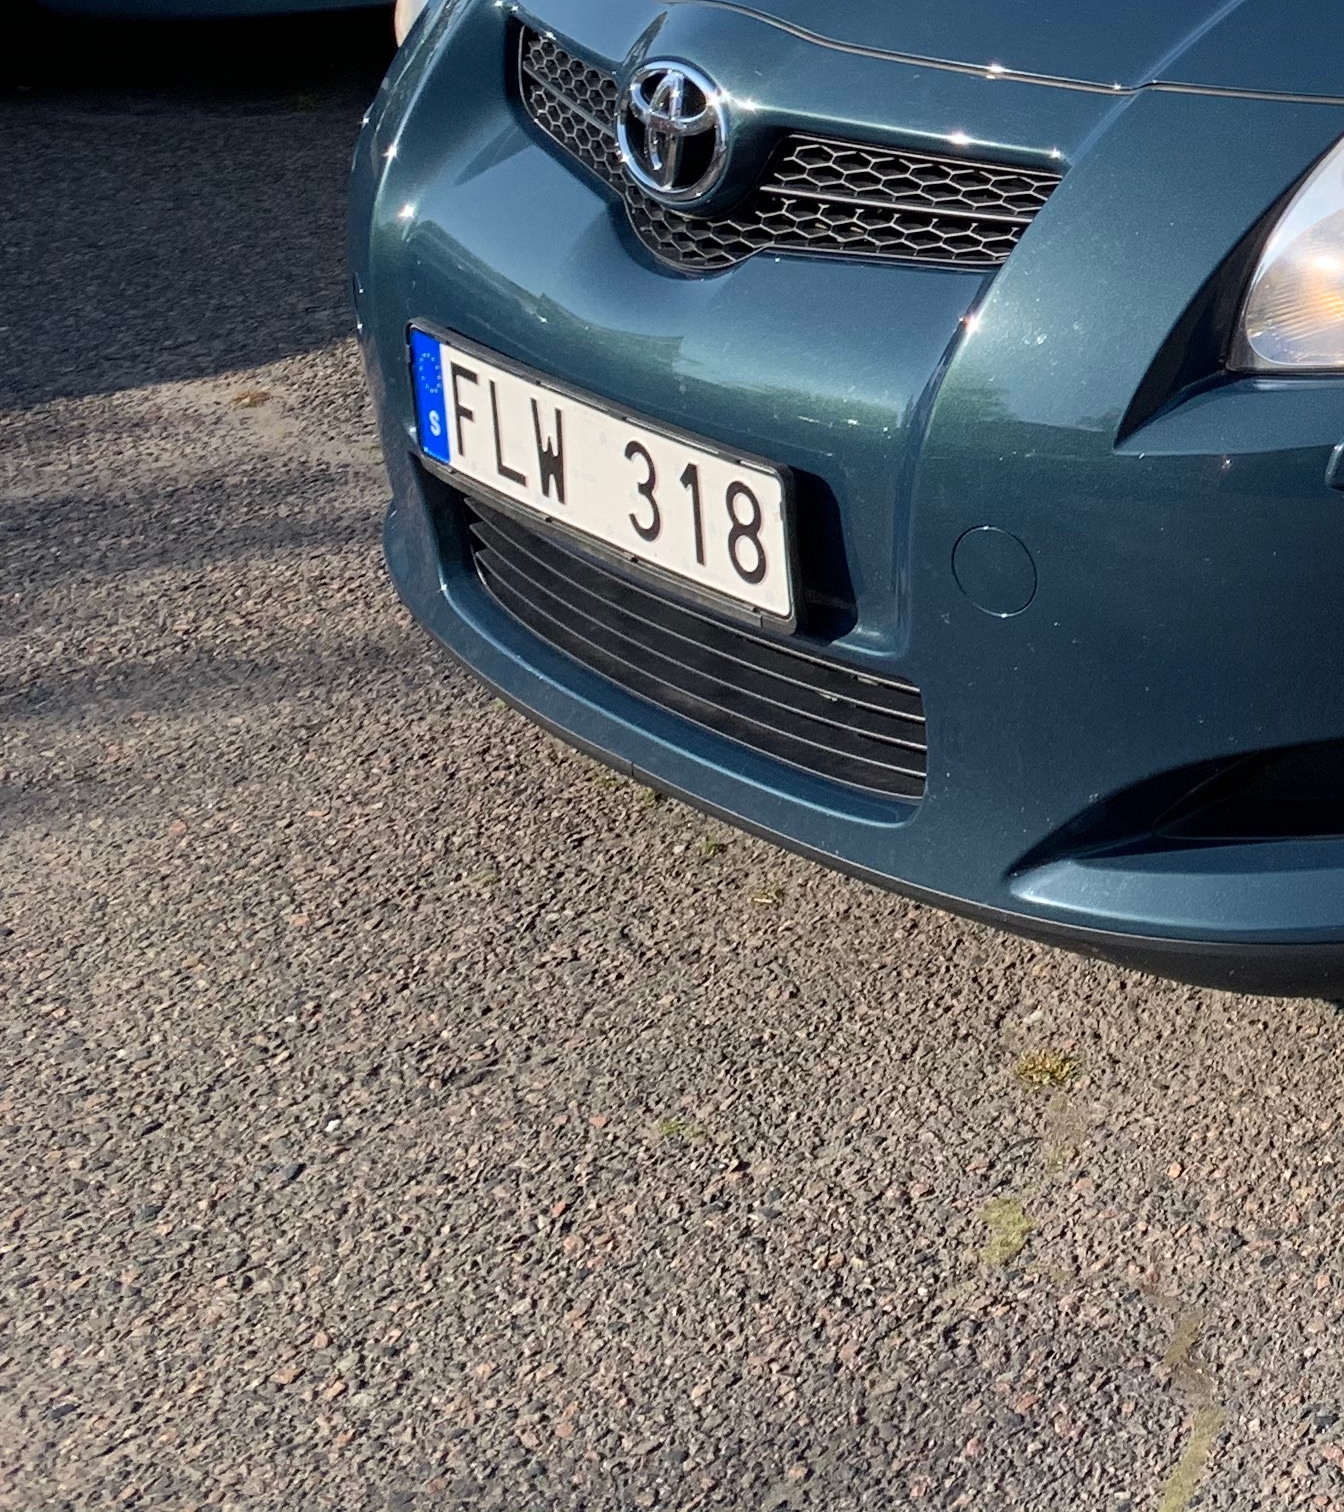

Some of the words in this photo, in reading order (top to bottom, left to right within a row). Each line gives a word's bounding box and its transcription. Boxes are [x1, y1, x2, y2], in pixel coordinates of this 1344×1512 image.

[428, 409, 443, 437] S
[450, 361, 566, 505] FLW
[624, 439, 768, 585] 318
